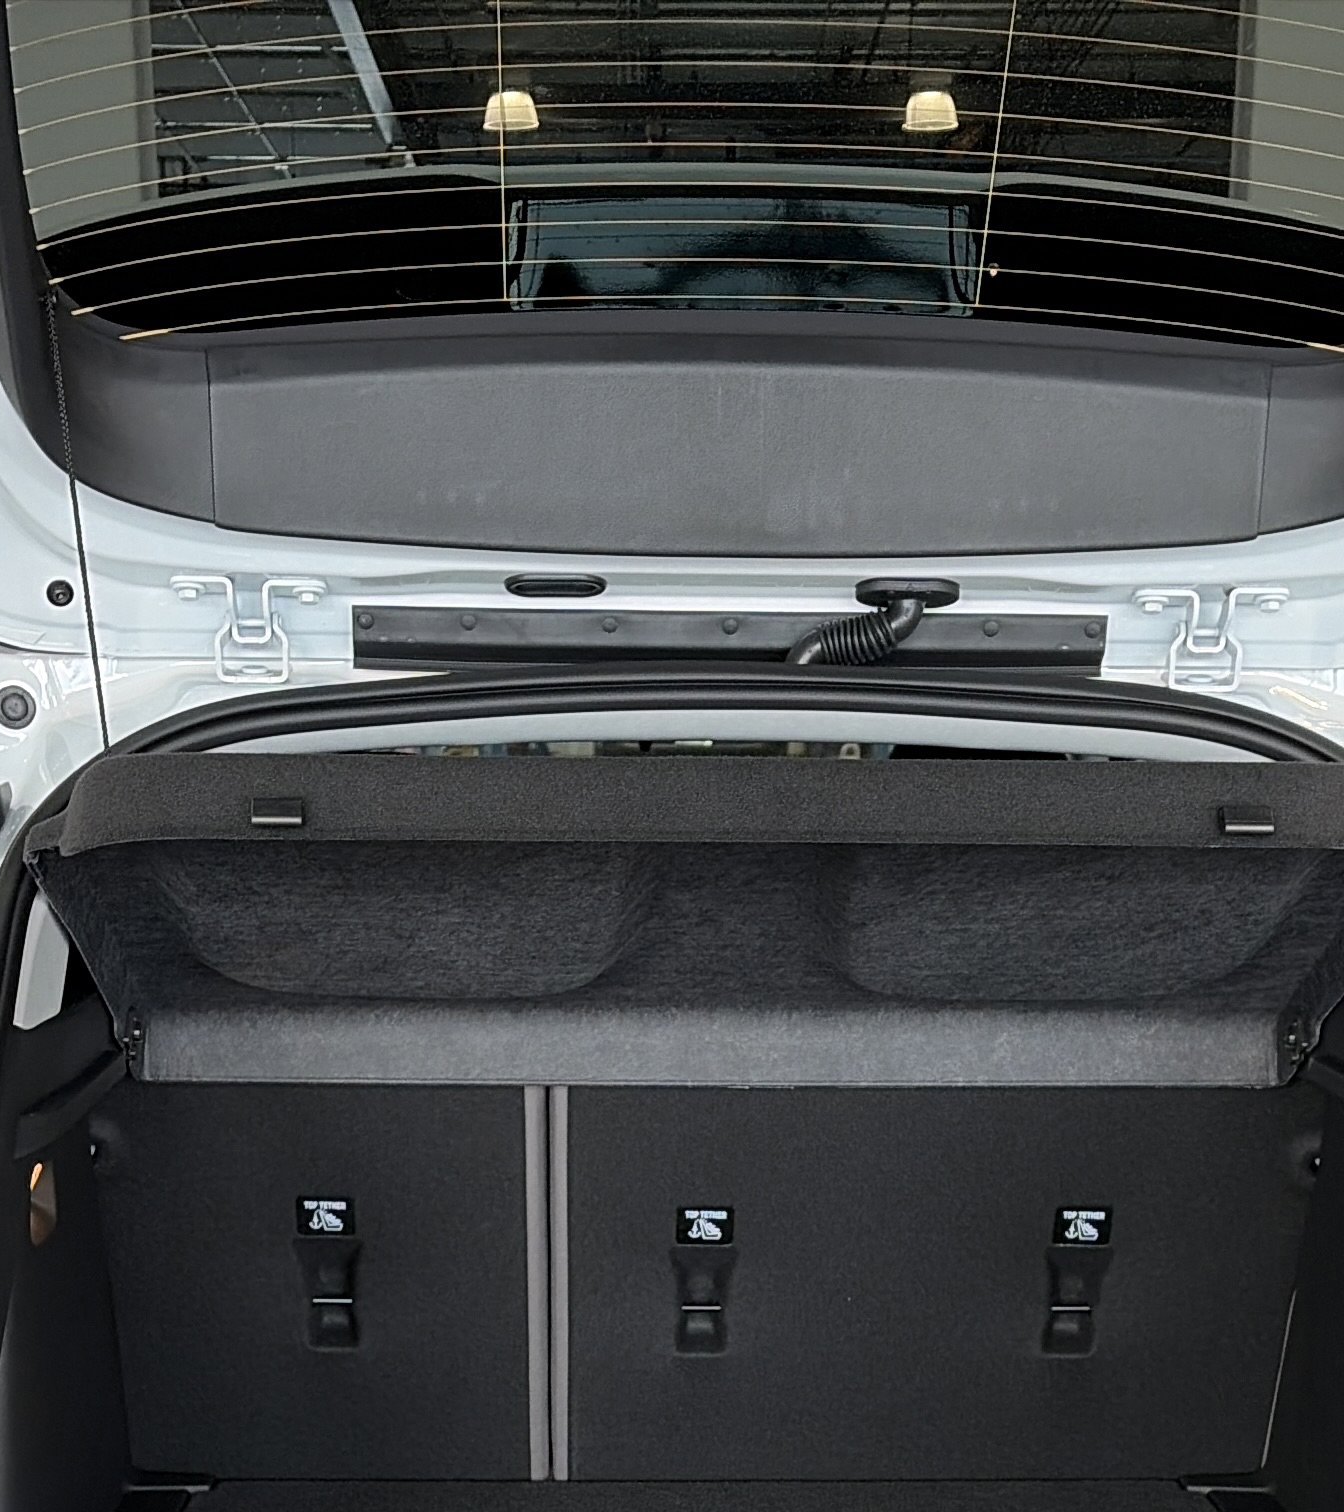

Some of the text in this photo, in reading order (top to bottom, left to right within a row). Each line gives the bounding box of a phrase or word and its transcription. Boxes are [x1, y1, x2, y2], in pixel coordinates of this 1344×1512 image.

[303, 1200, 347, 1210] TOP TETHER
[685, 1210, 727, 1219] TOP TETHER
[1063, 1210, 1106, 1220] TOP TETHER
